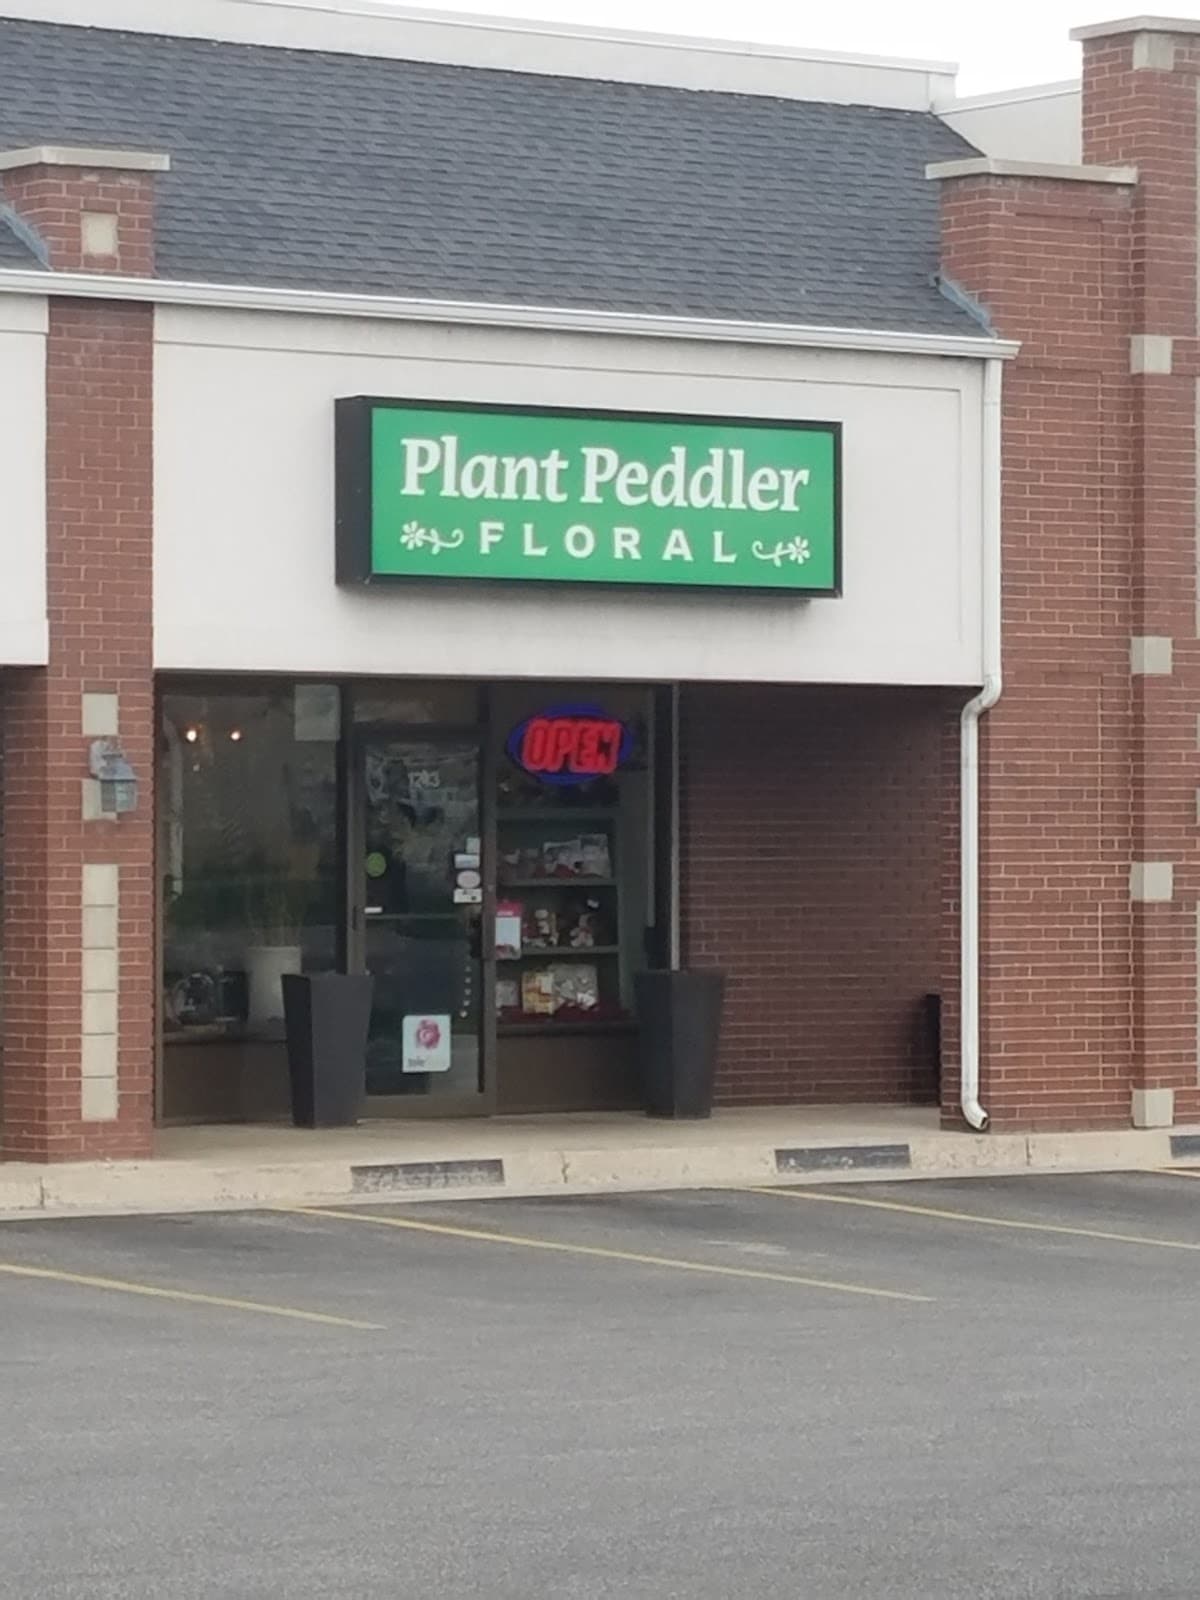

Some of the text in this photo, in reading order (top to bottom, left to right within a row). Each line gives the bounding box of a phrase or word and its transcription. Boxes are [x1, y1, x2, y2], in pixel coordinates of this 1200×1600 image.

[401, 435, 809, 512] Plant Peddler
[479, 521, 738, 563] FLORAL
[522, 717, 621, 773] OPEN
